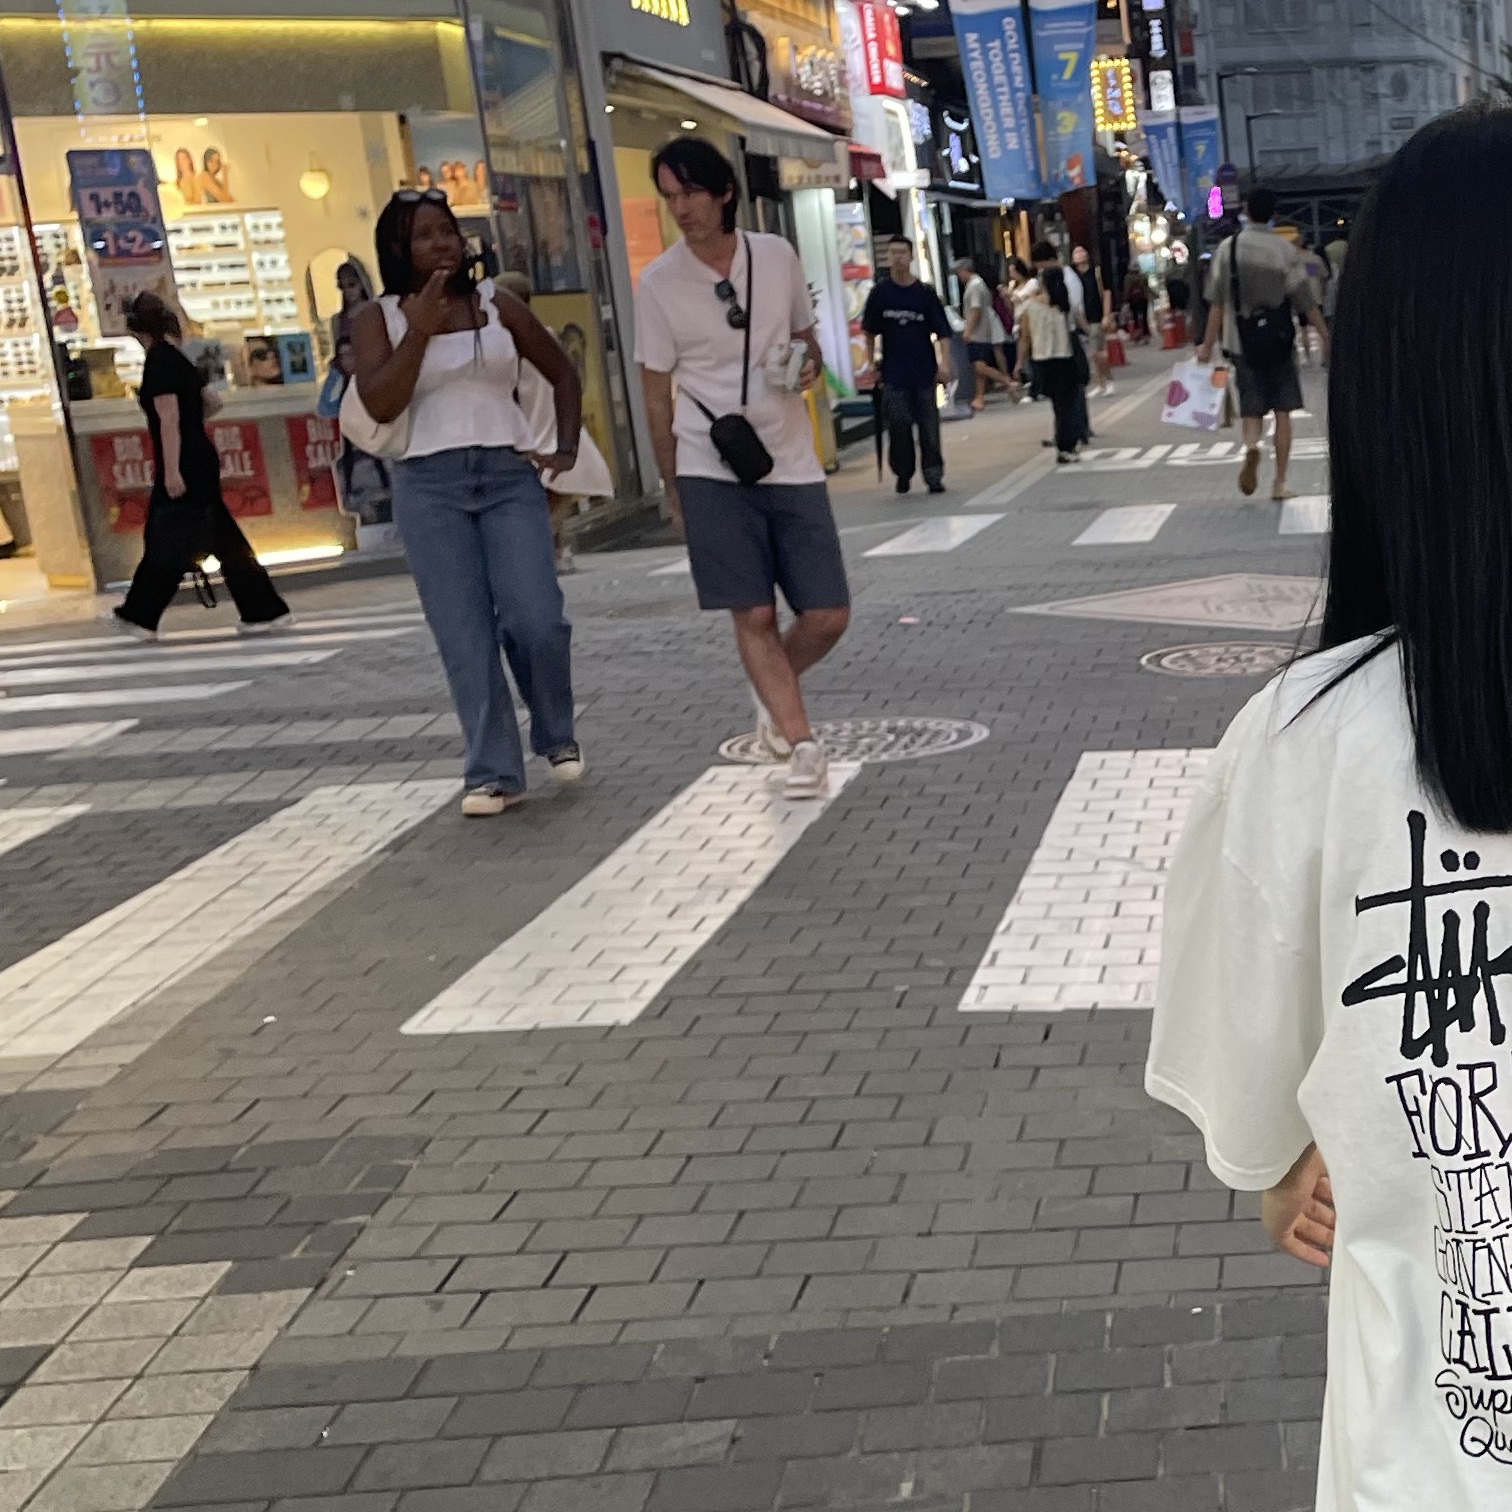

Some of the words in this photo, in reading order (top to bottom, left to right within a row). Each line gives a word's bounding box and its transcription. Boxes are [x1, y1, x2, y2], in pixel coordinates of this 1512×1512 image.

[965, 32, 1001, 159] MYEONGDONG
[986, 39, 1016, 129] TOGETHER
[1004, 131, 1019, 150] IN
[219, 451, 256, 478] ALE
